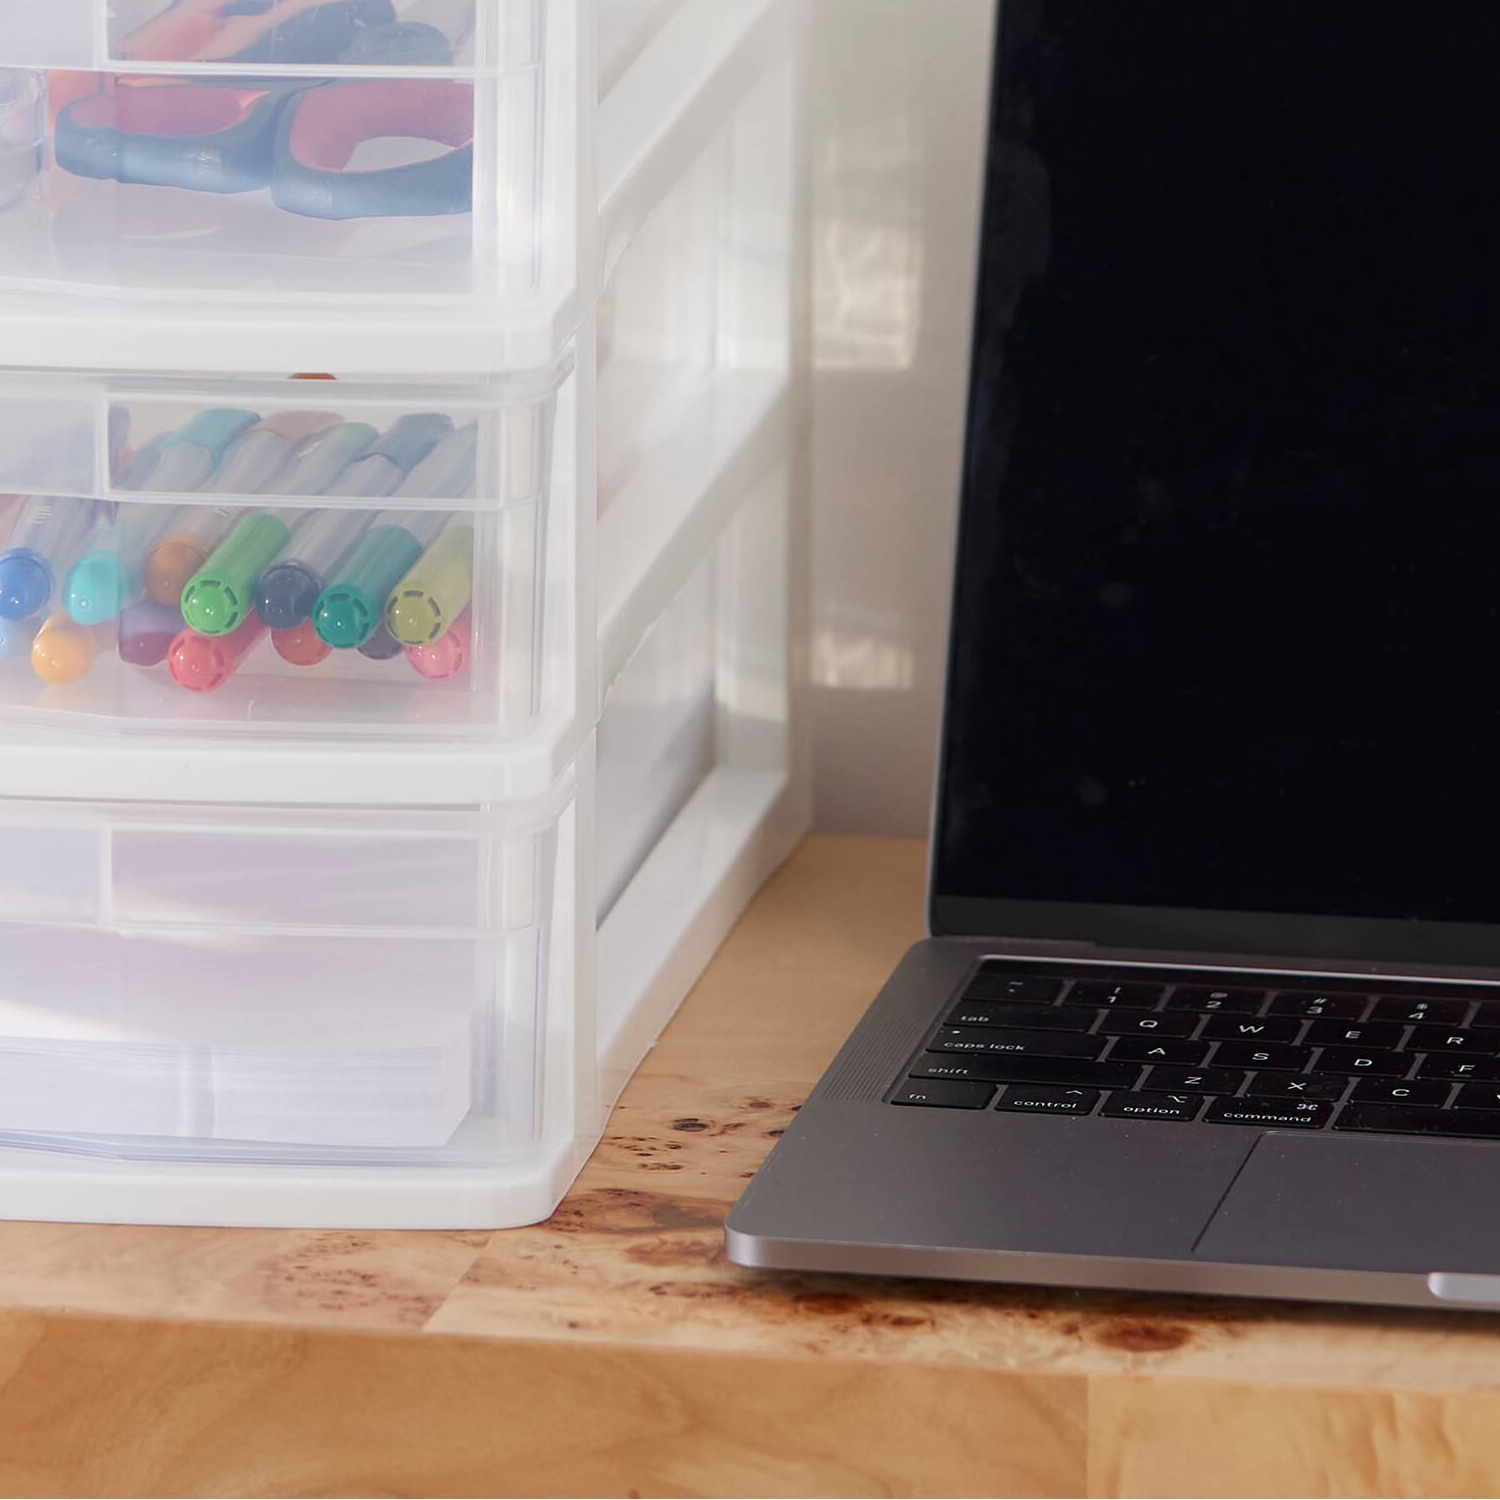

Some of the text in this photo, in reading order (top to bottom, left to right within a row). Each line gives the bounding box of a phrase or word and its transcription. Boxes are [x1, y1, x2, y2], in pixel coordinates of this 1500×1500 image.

[1139, 1019, 1158, 1029] Q
[1239, 1025, 1265, 1034] W
[1345, 1030, 1361, 1039] E
[1446, 1036, 1464, 1045] R
[943, 1042, 1024, 1051] caps lock
[1147, 1047, 1166, 1055] A
[1252, 1052, 1269, 1061] S
[1354, 1058, 1373, 1067] D
[928, 1067, 968, 1075] shift
[1459, 1064, 1475, 1073] F
[1184, 1076, 1202, 1085] Z
[1287, 1082, 1307, 1091] X
[1391, 1088, 1410, 1097] C
[1013, 1100, 1077, 1109] control
[1123, 1107, 1180, 1115] option
[1223, 1112, 1312, 1122] command
